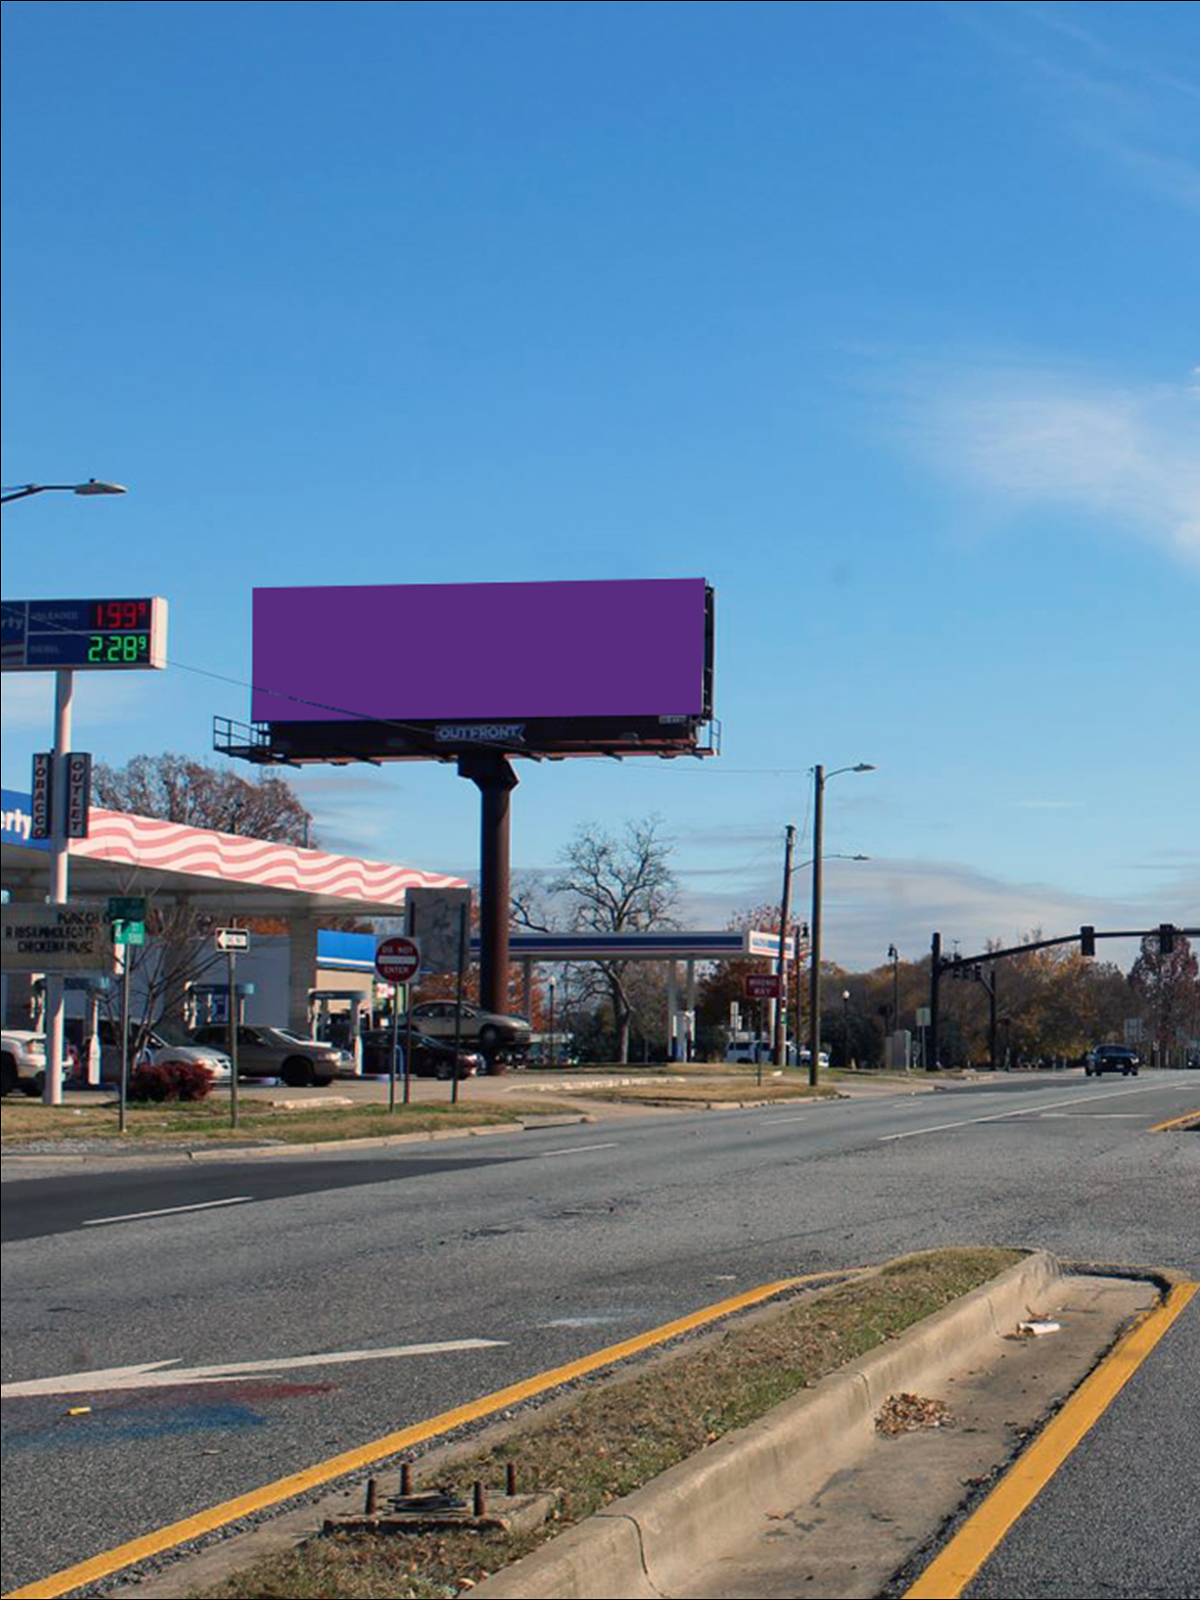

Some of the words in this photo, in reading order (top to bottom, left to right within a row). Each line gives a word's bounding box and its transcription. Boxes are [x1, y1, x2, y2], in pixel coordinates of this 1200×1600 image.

[438, 725, 521, 739] OUTFRONT
[35, 756, 46, 837] TOBACCO
[71, 760, 83, 830] OUTLET
[384, 966, 409, 974] ENTER
